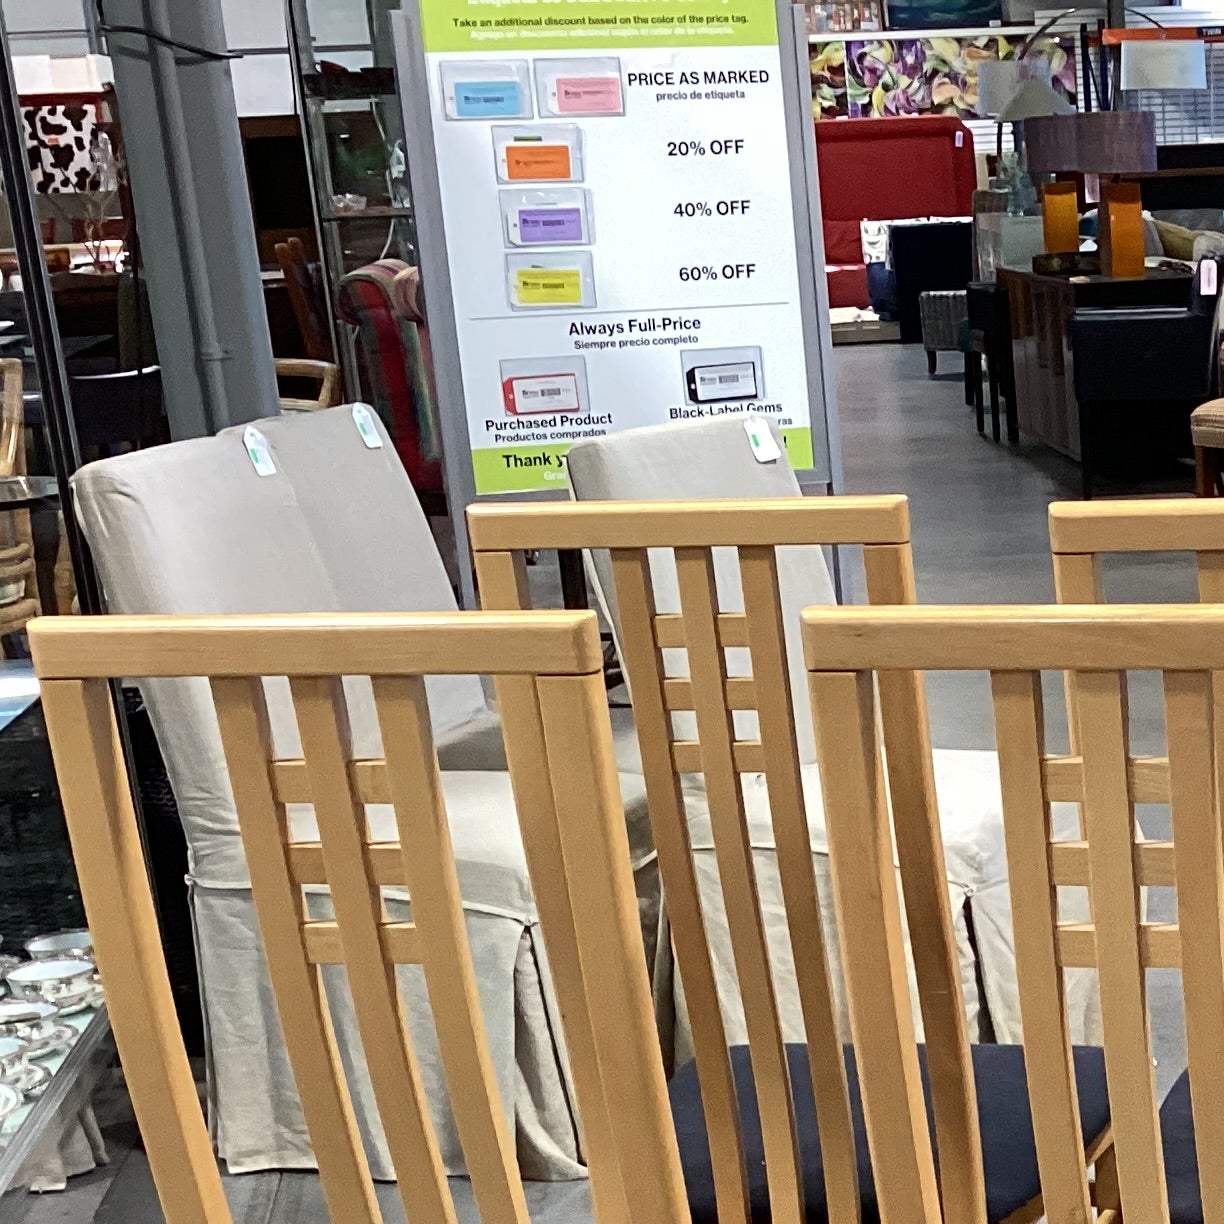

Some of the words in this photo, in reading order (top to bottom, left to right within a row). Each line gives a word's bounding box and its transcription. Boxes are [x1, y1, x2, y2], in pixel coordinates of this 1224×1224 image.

[453, 18, 477, 27] Take
[494, 17, 542, 26] additional
[544, 16, 590, 26] discount
[588, 16, 617, 25] based
[634, 16, 648, 24] the
[650, 15, 674, 24] color
[677, 15, 686, 24] of
[688, 15, 703, 24] the
[706, 15, 729, 25] price
[628, 72, 674, 86] PRICE
[679, 72, 700, 85] AS
[704, 70, 770, 84] MARKED
[656, 91, 688, 102] precio
[690, 90, 702, 100] de
[705, 90, 745, 100] etiqueta
[667, 141, 706, 156] 20%
[710, 139, 744, 154] OFF
[674, 202, 712, 217] 40%
[716, 200, 750, 216] OFF
[679, 266, 718, 282] 60%
[722, 264, 756, 280] OFF
[569, 322, 624, 337] Always
[628, 316, 701, 334] Full-Price
[574, 339, 616, 350] Siempre
[618, 337, 650, 348] precio
[652, 334, 698, 346] completo
[486, 416, 556, 431] Purchased
[560, 413, 613, 427] Product
[495, 432, 548, 443] Productos
[550, 428, 606, 440] comprados
[502, 452, 550, 468] Thank
